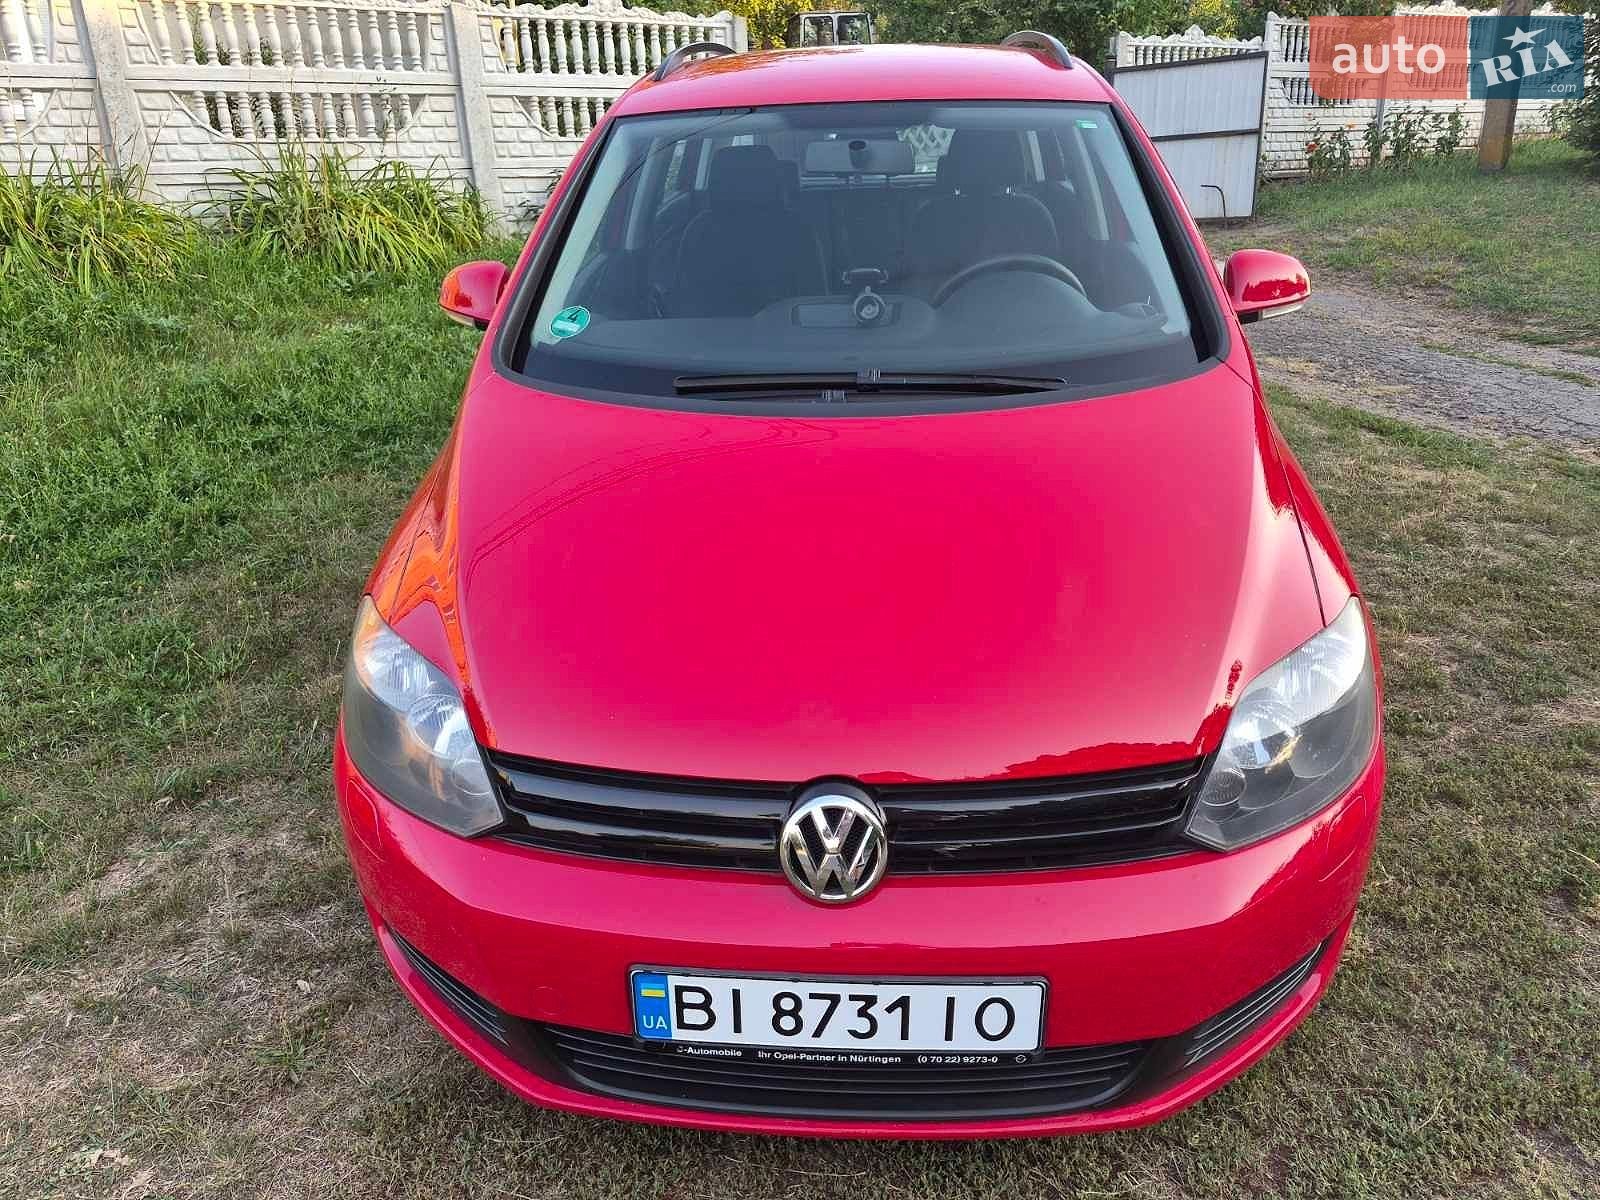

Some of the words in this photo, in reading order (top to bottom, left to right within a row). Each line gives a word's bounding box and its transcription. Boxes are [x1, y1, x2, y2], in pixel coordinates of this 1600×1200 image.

[567, 309, 581, 322] 4
[674, 984, 743, 1034] BI
[771, 991, 910, 1041] 8731
[945, 996, 1015, 1042] IO
[643, 1015, 668, 1030] UA
[758, 1050, 771, 1058] Ihr
[774, 1051, 836, 1061] Opel-Partner
[838, 1053, 847, 1062] in
[850, 1054, 901, 1064] Nürtingen
[918, 1054, 928, 1064] (0
[930, 1055, 942, 1064] 70
[945, 1055, 961, 1064] 22)
[963, 1055, 998, 1063] 9273-0
